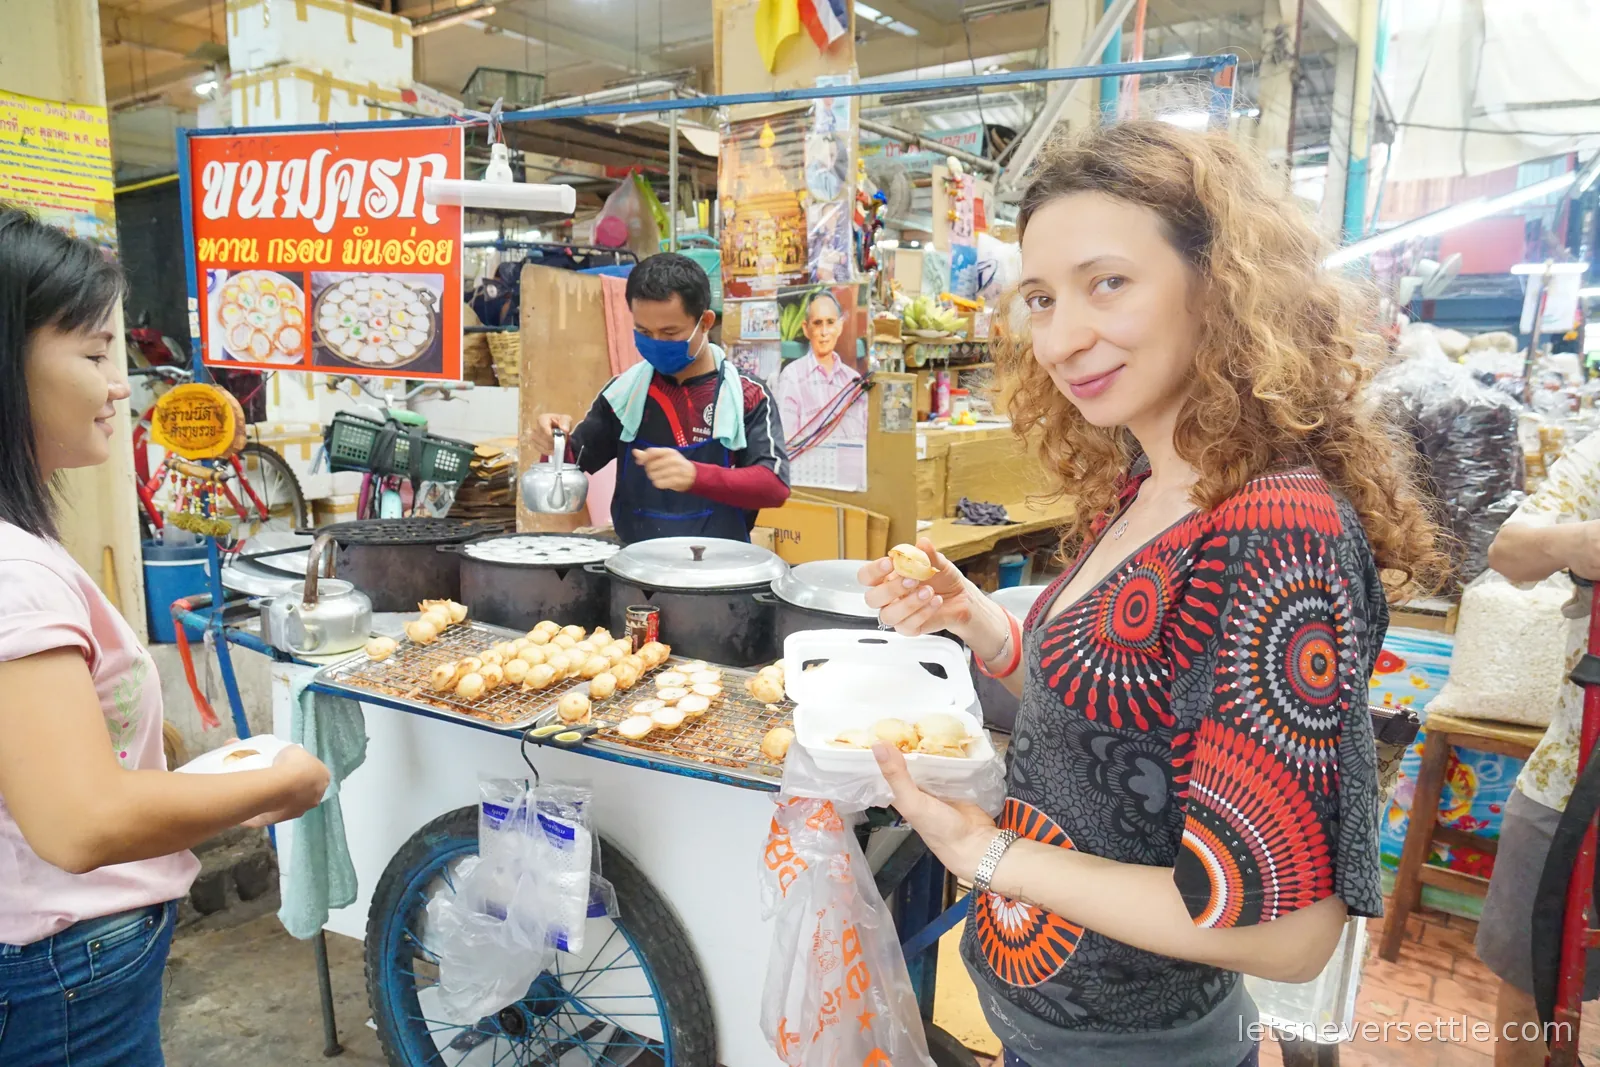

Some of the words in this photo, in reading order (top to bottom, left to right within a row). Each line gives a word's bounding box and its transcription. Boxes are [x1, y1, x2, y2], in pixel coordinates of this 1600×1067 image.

[202, 148, 448, 233] ขนมครก
[198, 237, 259, 264] หวาน
[267, 237, 332, 264] กรอบ
[342, 226, 453, 265] มันอร่อย
